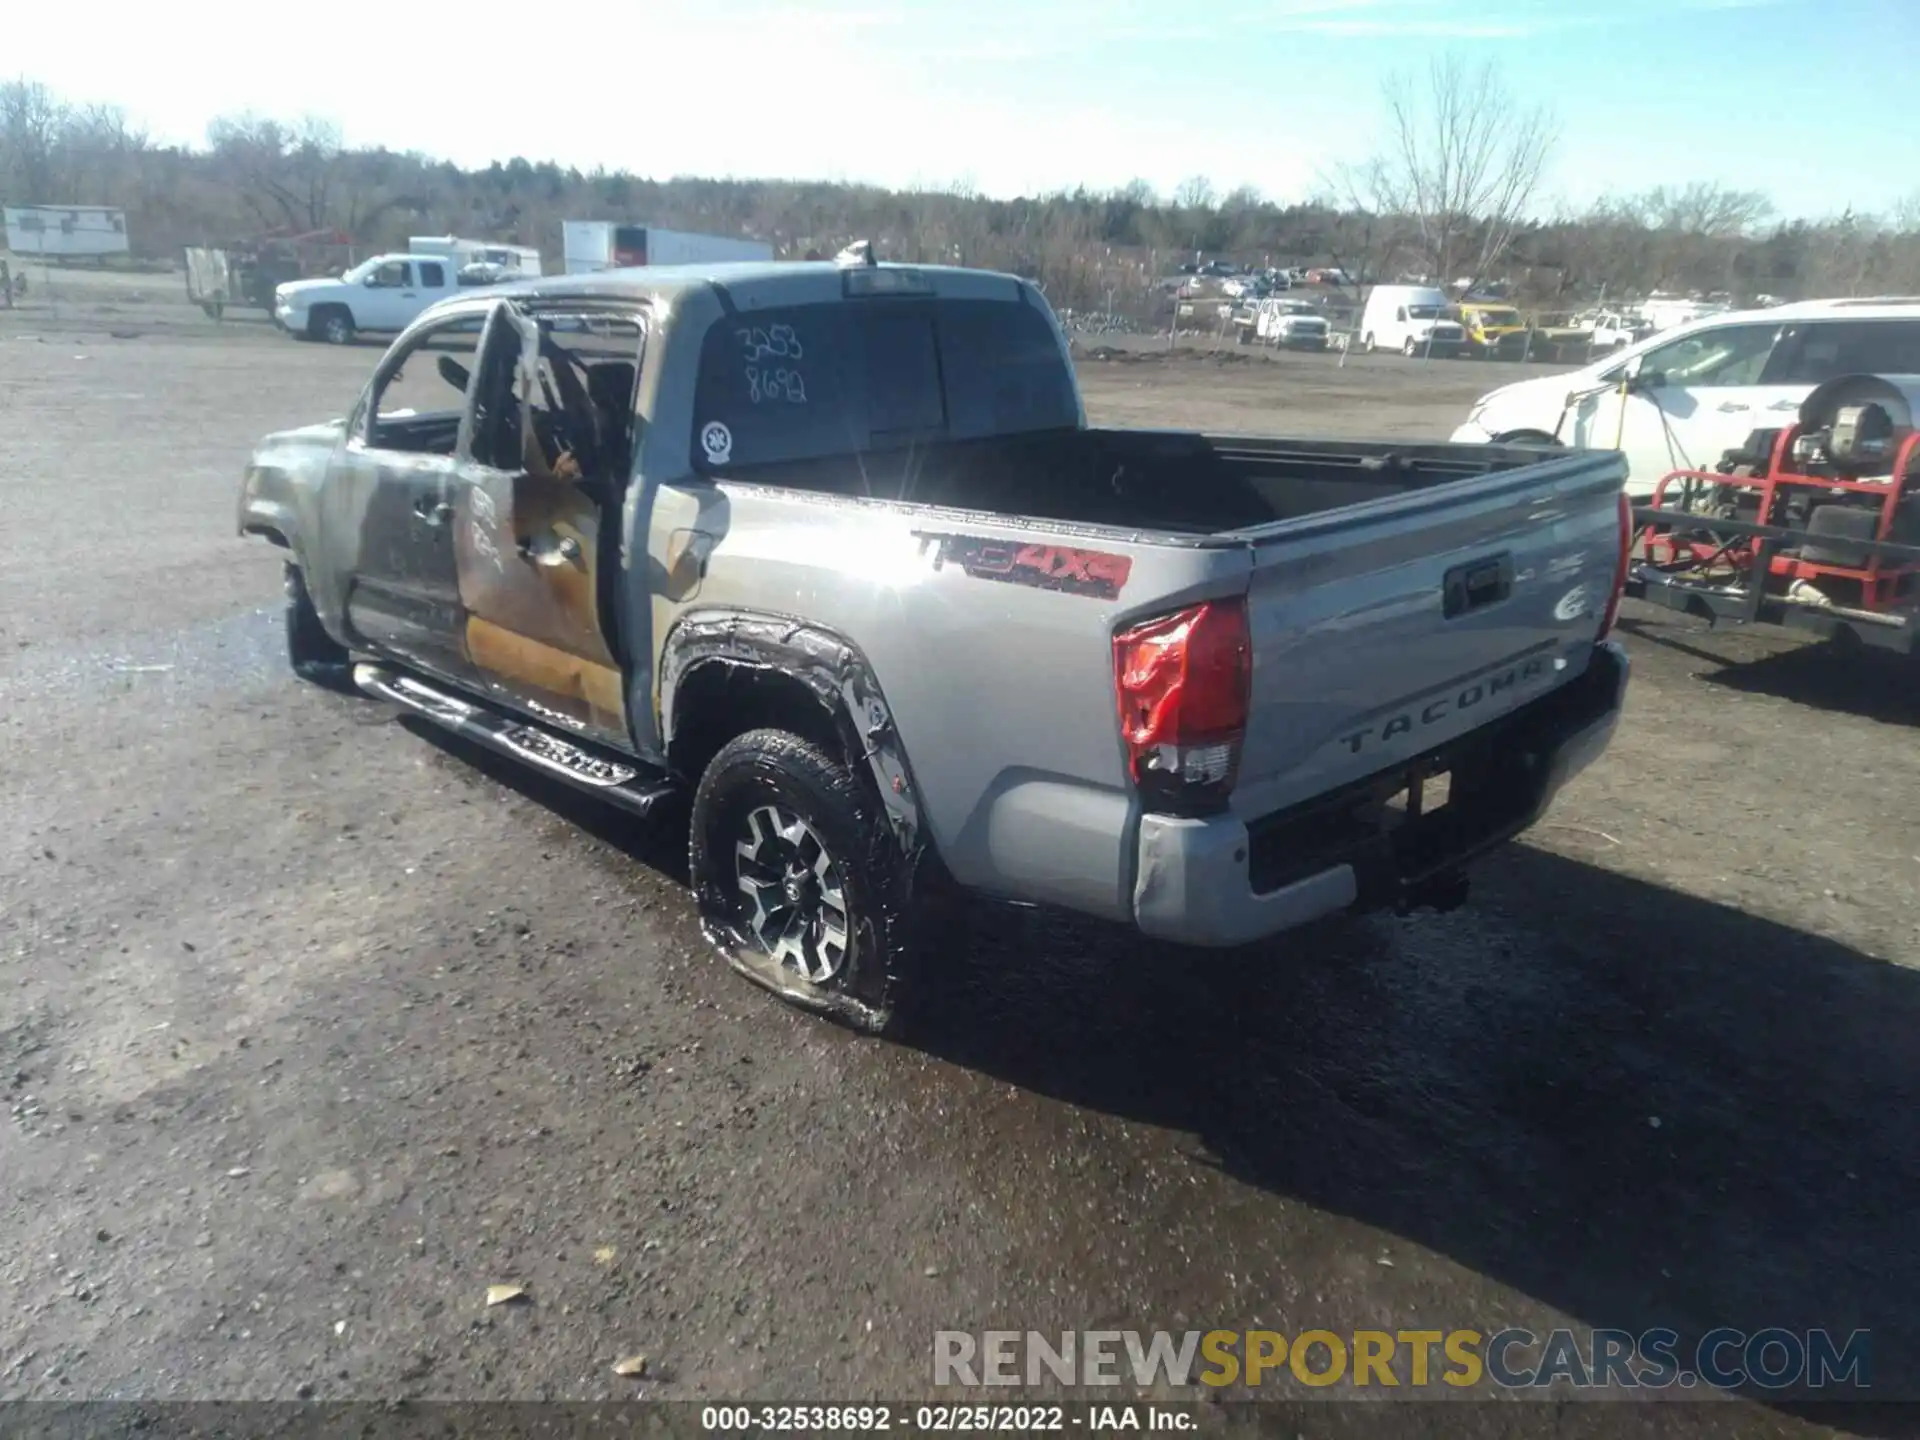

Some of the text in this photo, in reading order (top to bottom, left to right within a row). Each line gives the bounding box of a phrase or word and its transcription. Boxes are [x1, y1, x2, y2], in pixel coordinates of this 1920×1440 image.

[735, 323, 803, 361] 3253
[745, 366, 807, 404] 8692
[1339, 660, 1543, 753] TACOMA
